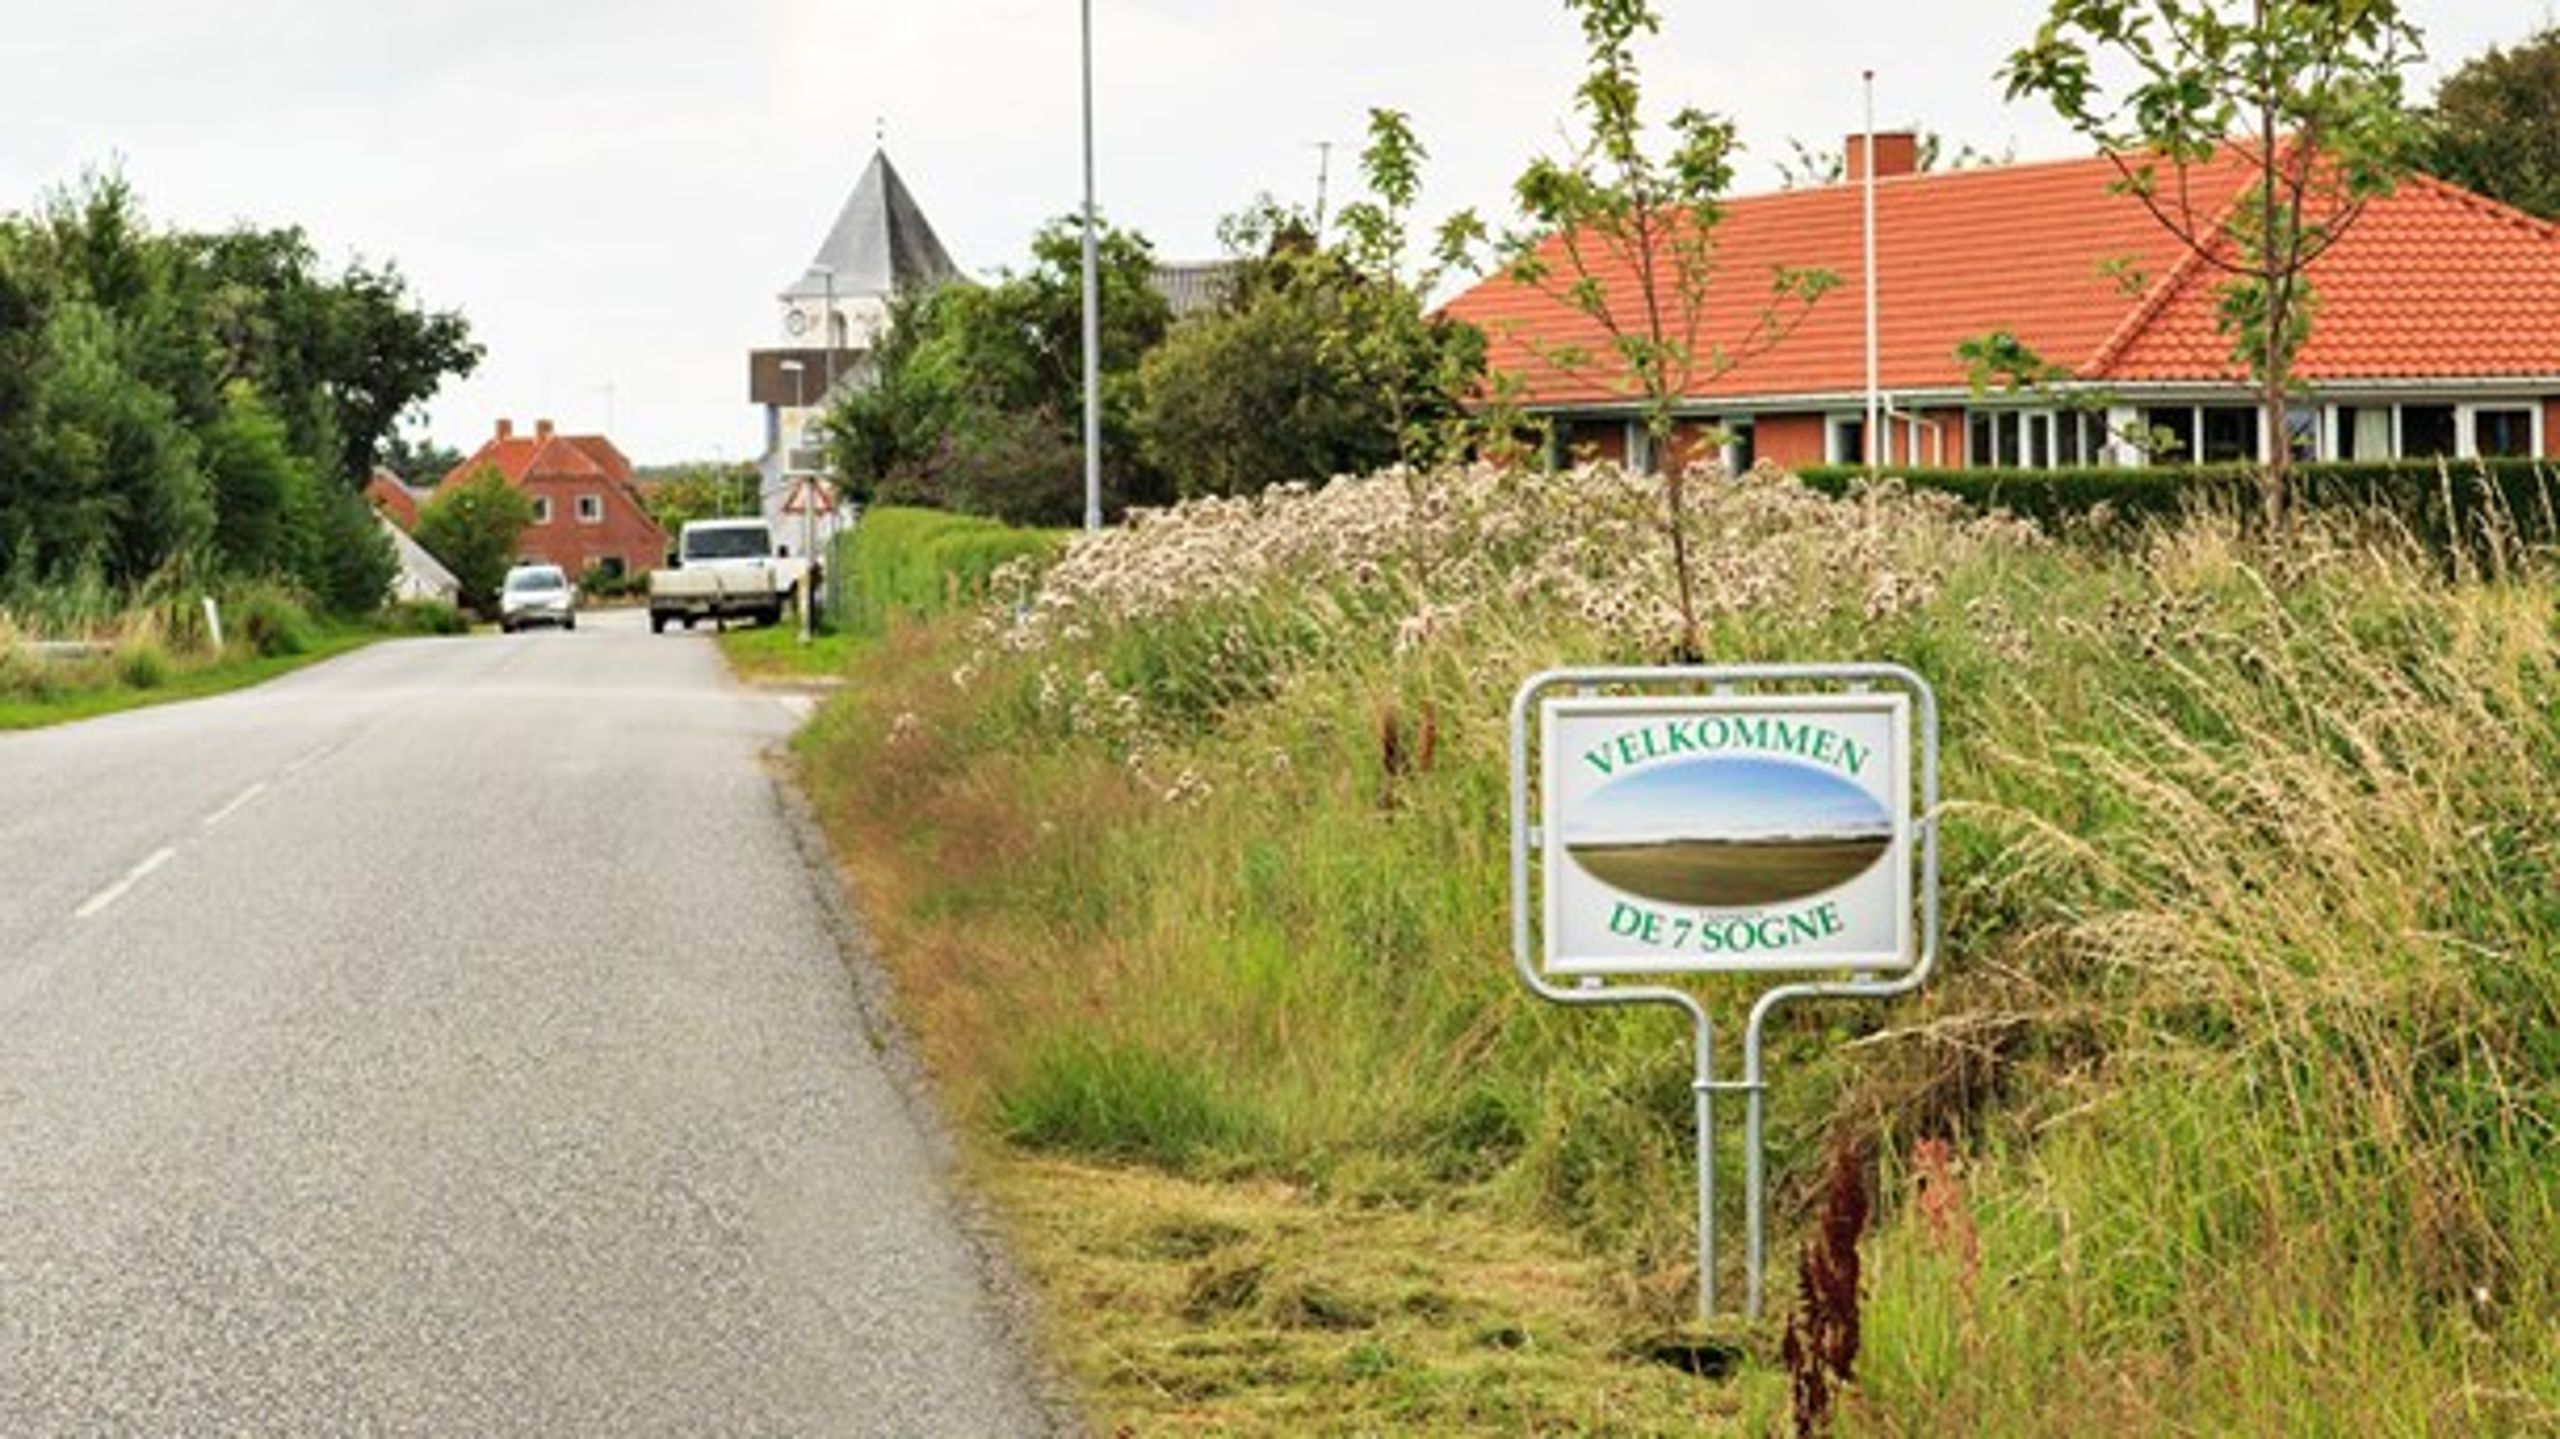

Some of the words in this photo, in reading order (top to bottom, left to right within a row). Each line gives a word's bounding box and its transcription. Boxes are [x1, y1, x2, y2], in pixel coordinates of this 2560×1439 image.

[1584, 717, 1870, 775] VELKOMMEN
[1609, 901, 1663, 944] DE
[1673, 920, 1694, 950] 7
[1701, 901, 1844, 952] SOGNE
